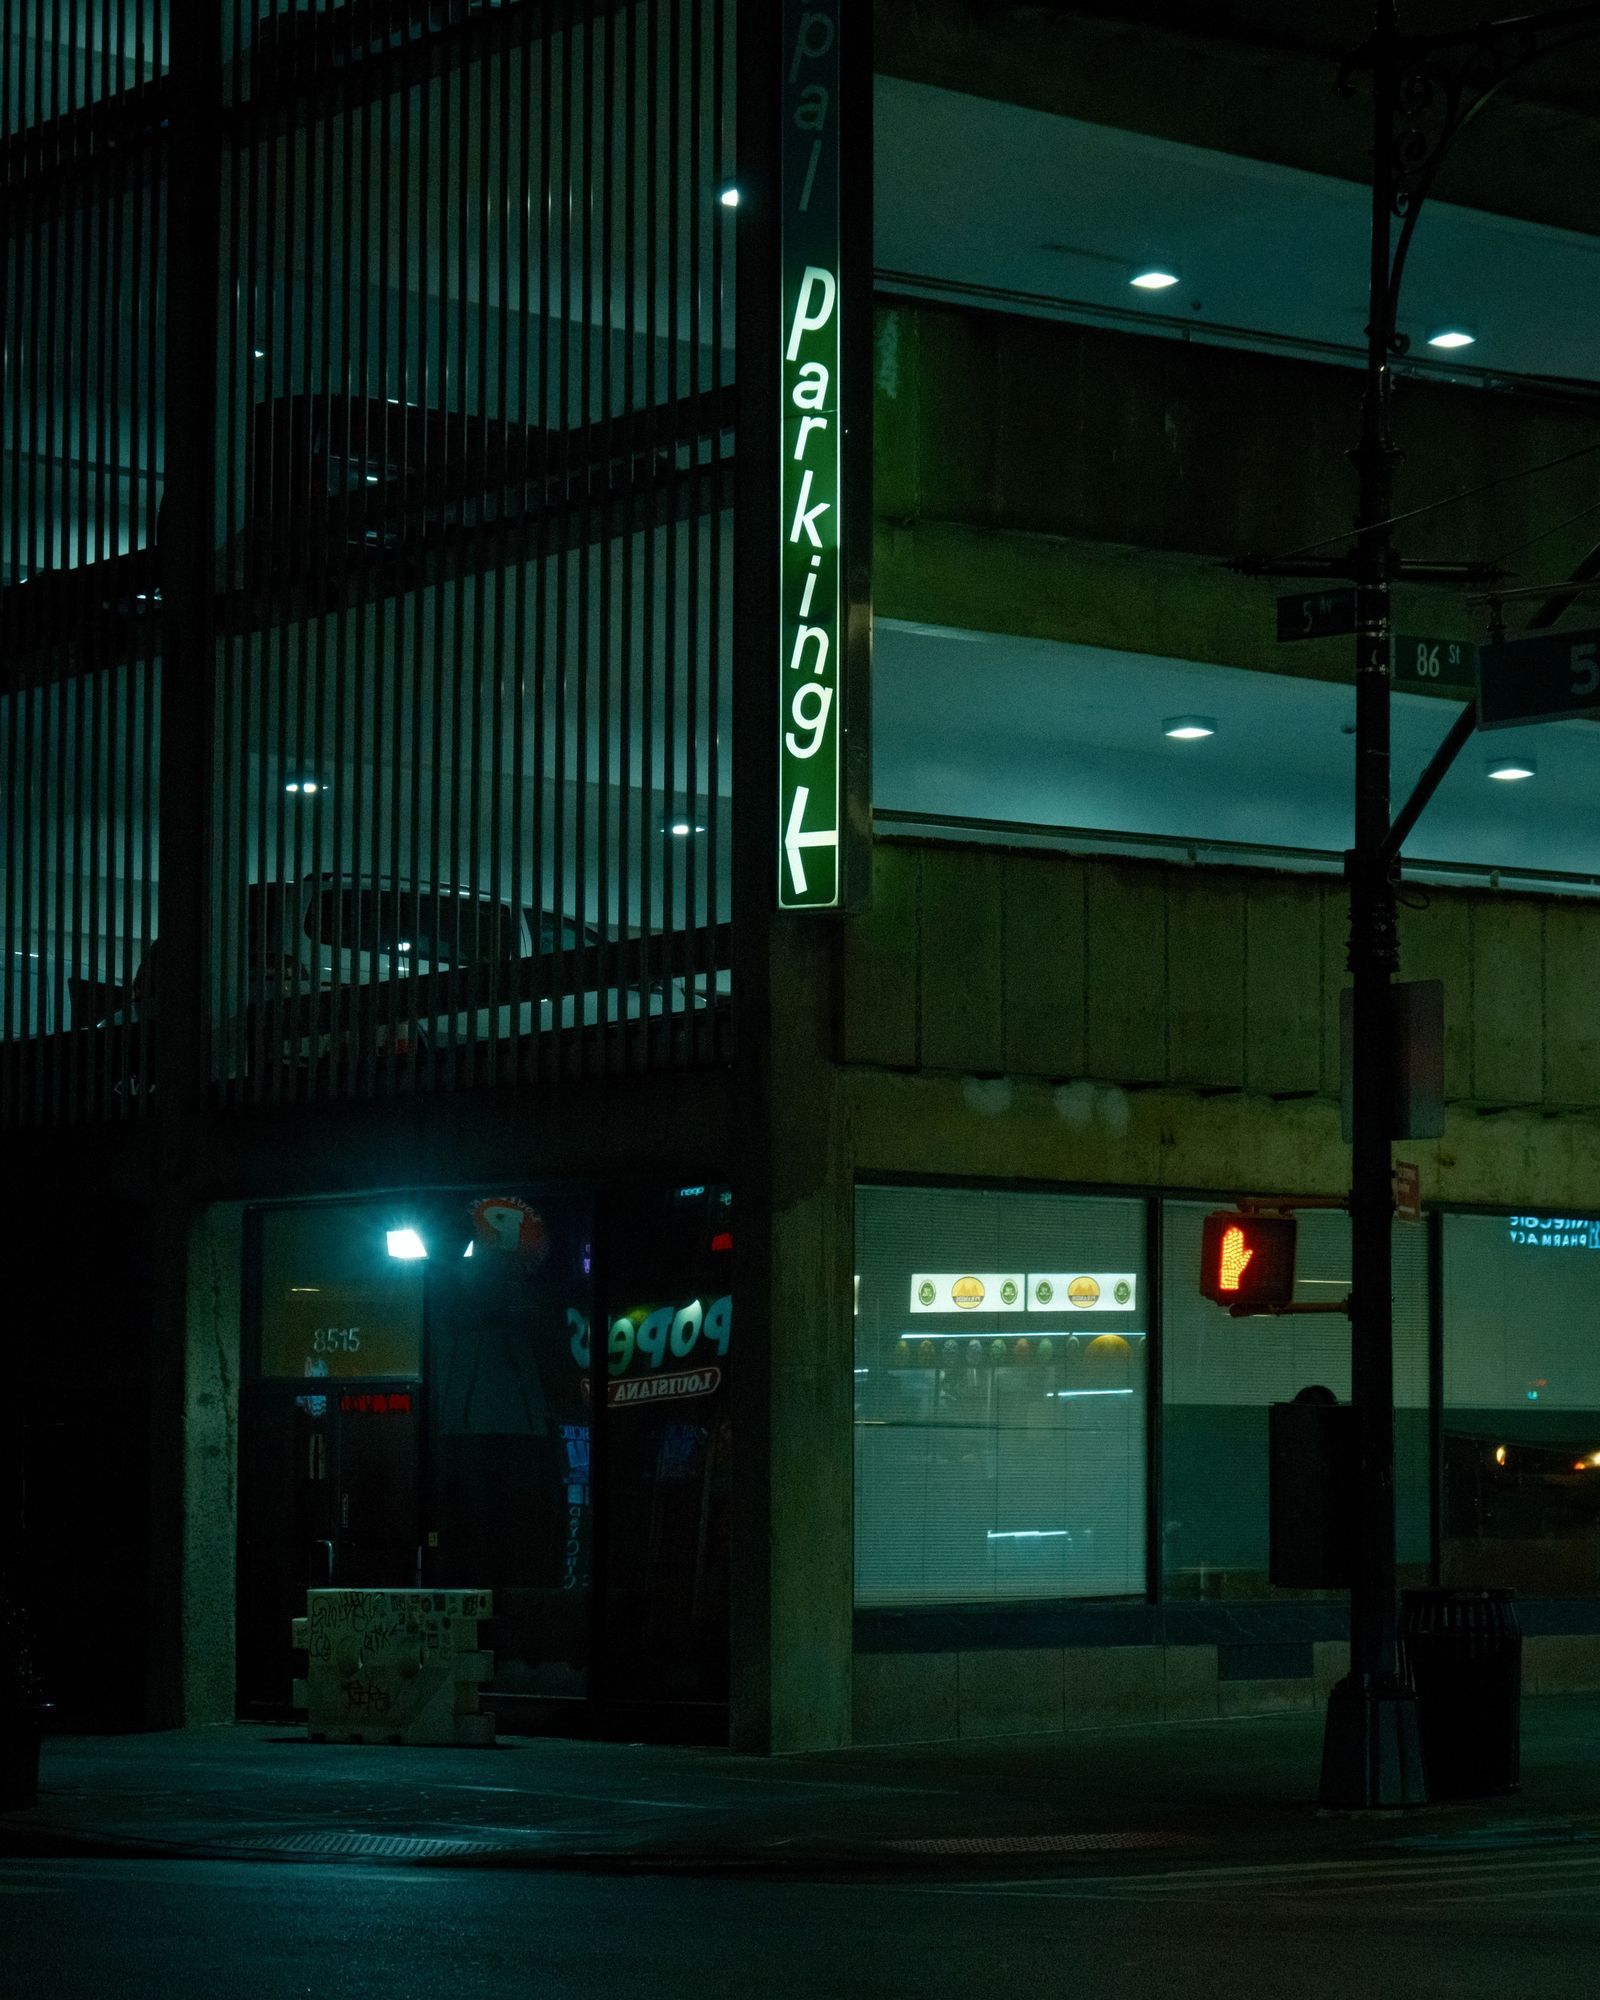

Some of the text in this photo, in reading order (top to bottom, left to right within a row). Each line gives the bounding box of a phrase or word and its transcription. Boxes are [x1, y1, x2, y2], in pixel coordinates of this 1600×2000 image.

[788, 0, 835, 212] pal
[784, 265, 837, 760] Parking
[1302, 599, 1313, 633] 5
[1416, 643, 1440, 678] 86
[1569, 642, 1600, 696] 5
[313, 1327, 360, 1353] 8515
